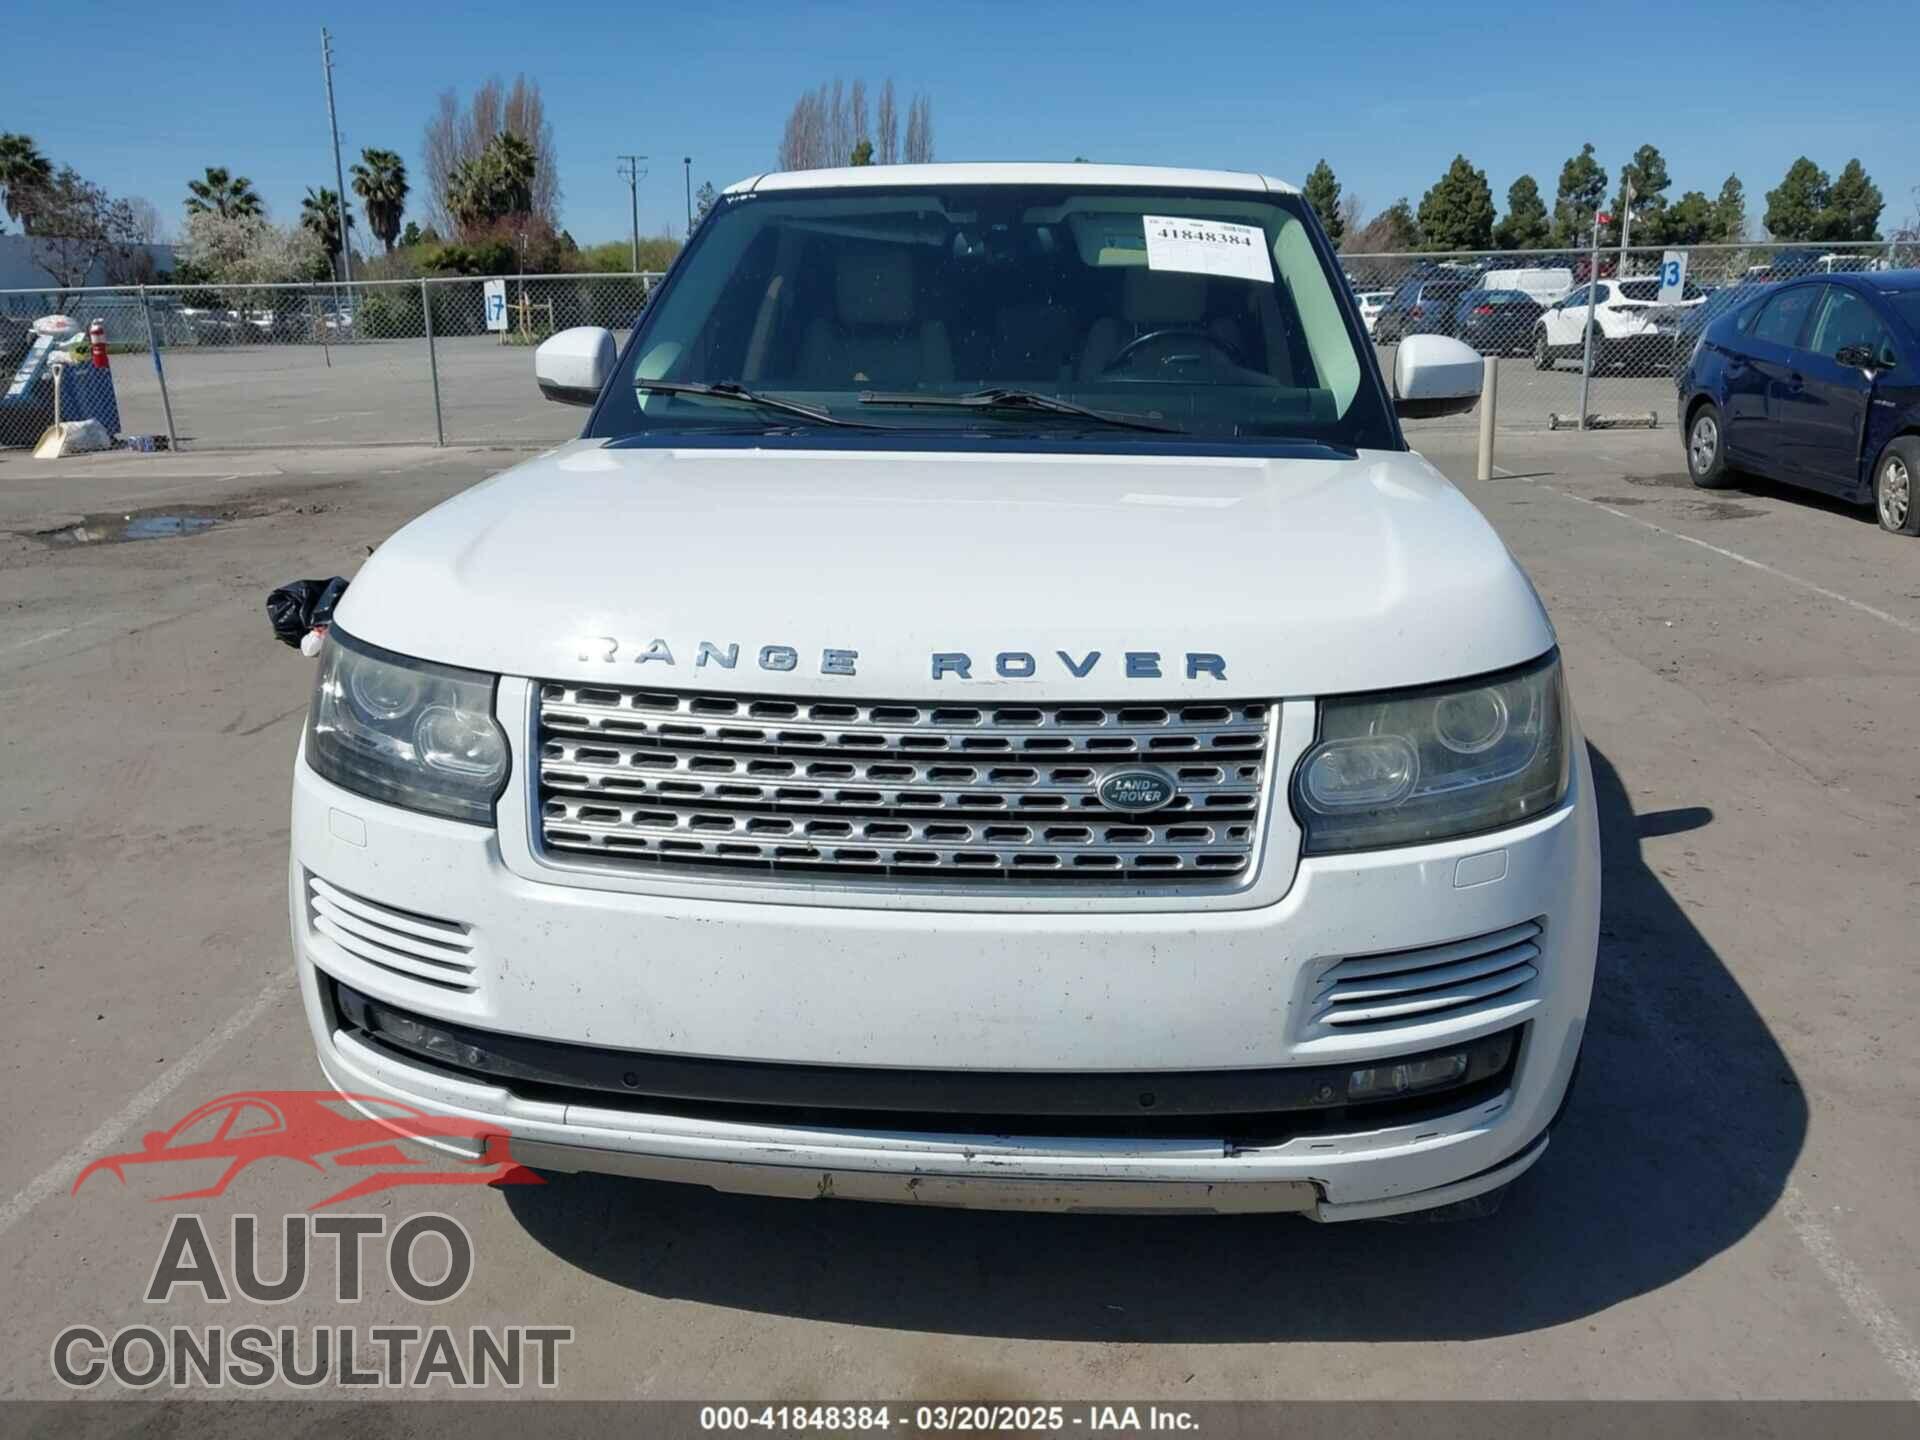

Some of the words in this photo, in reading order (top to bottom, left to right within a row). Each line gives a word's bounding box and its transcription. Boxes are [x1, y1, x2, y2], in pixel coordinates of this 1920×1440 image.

[1157, 228, 1251, 246] 41848384
[1659, 260, 1681, 288] 13
[487, 294, 505, 321] 17
[577, 636, 859, 677] RANGE
[931, 650, 1228, 681] ROVER
